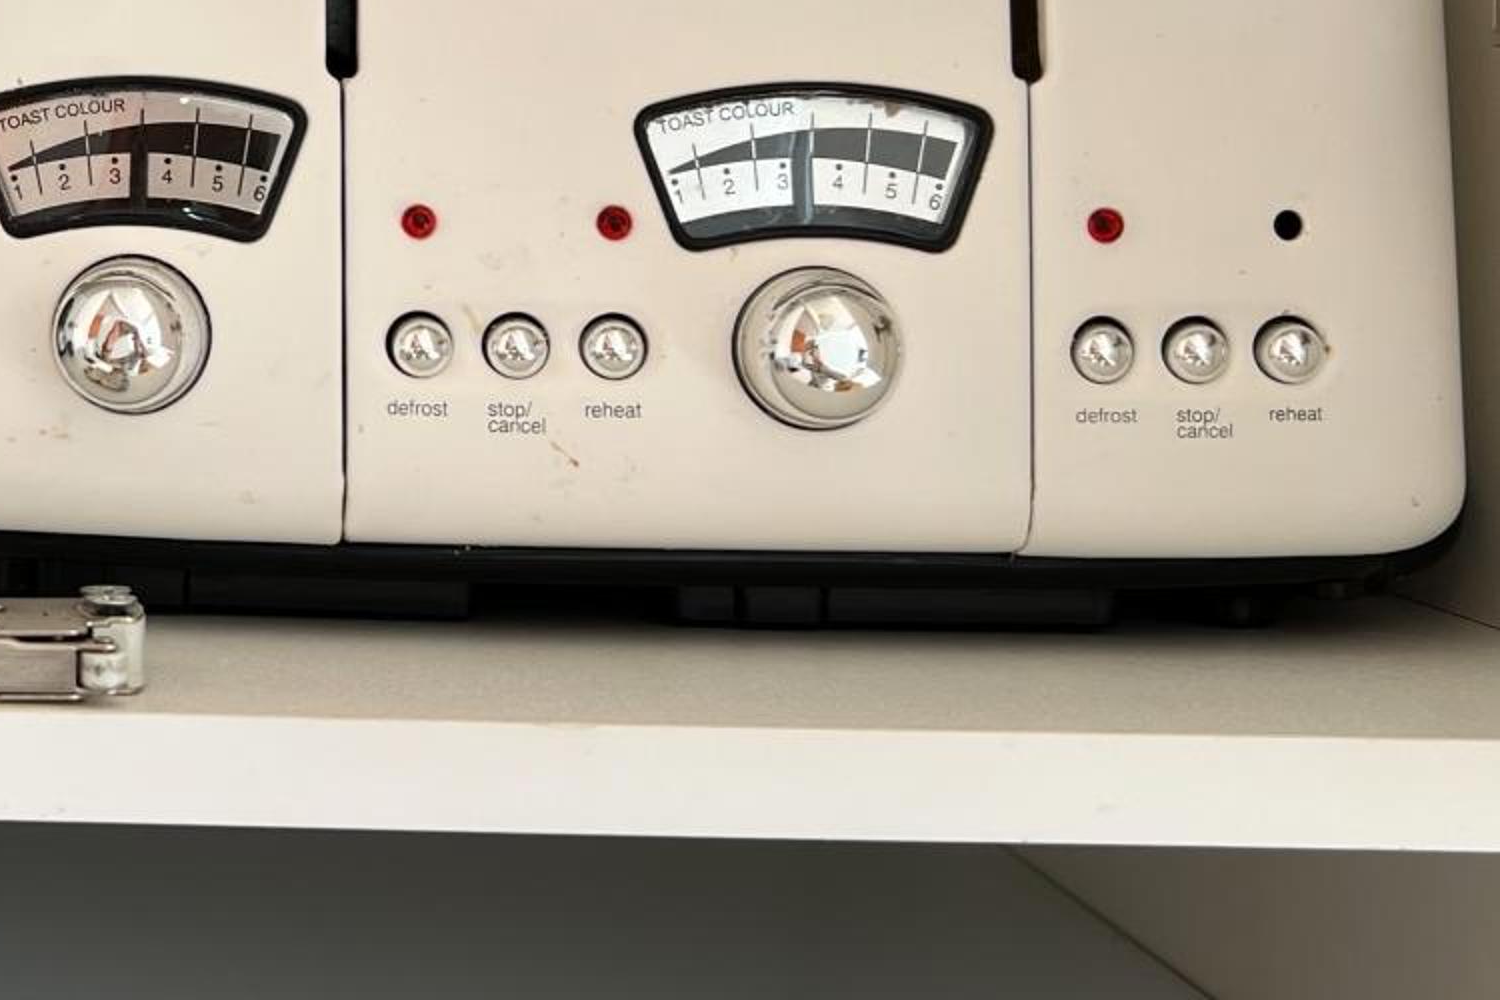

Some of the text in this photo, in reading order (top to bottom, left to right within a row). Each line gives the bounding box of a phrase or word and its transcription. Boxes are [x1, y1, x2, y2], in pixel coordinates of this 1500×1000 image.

[55, 98, 125, 119] COLOUR
[658, 101, 795, 135] TOAST COLOUR
[14, 168, 266, 200] 1 2 3 4 5 6
[674, 173, 942, 212] 1 2 3 4 5 6
[387, 400, 449, 417] defrost
[487, 401, 533, 419] stop/
[584, 402, 643, 418] reheat
[1075, 407, 1138, 424] defrost
[1175, 407, 1221, 425] stop/
[1268, 406, 1323, 422] reheat
[487, 417, 547, 434] cancel
[1176, 423, 1234, 439] cancel
